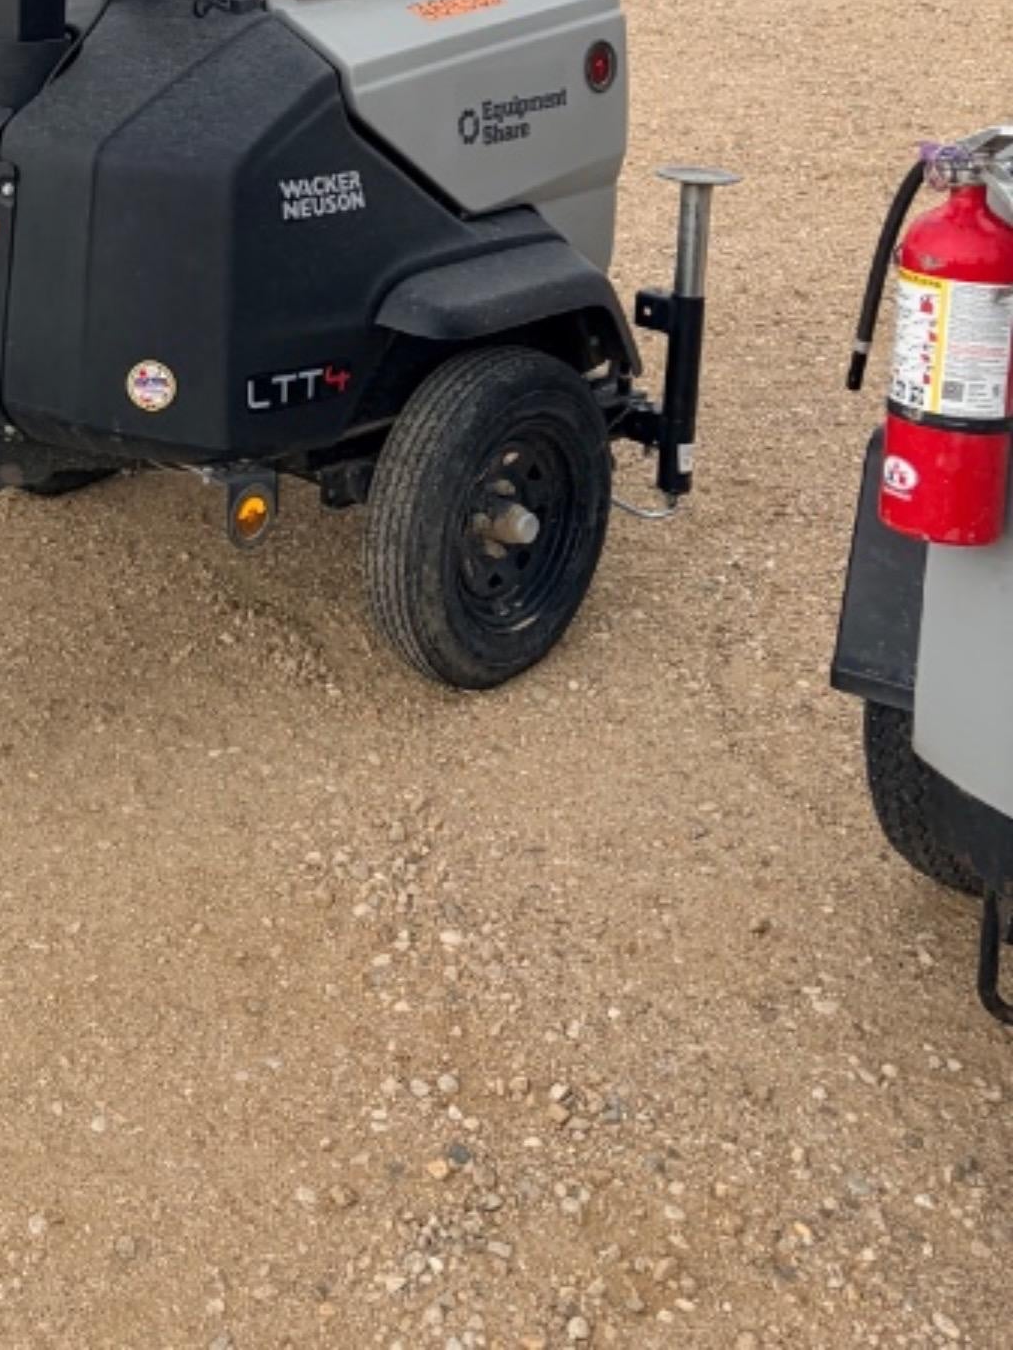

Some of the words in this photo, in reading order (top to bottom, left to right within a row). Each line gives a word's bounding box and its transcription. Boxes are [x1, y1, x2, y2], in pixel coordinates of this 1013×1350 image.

[481, 88, 568, 123] Equipment
[481, 122, 531, 146] Share
[278, 170, 362, 200] WACKER
[282, 187, 367, 221] NEUSON
[246, 364, 352, 410] LTT4
